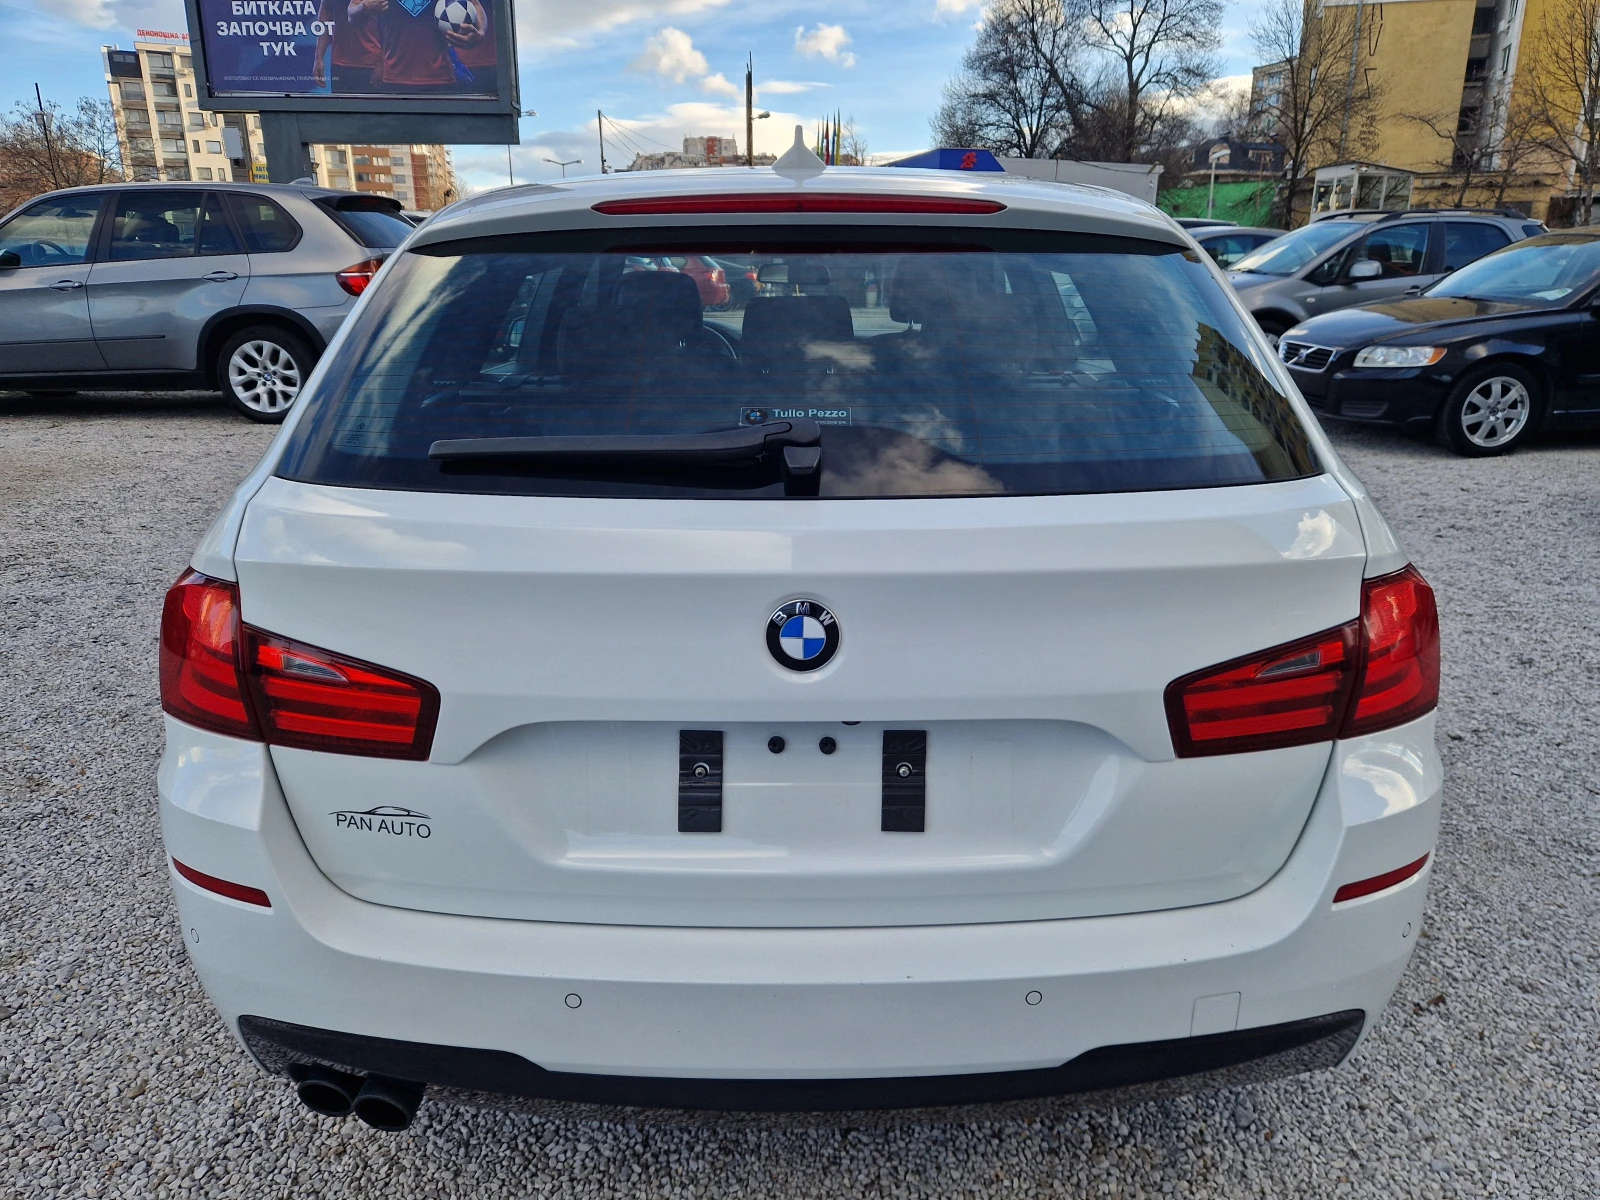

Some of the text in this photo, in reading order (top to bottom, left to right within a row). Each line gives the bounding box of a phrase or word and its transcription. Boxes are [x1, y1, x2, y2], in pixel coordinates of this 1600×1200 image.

[231, 1, 317, 16] БИТКАТА
[216, 21, 335, 36] ЗАПОЧВА ОТ
[259, 41, 298, 57] ТУК
[772, 408, 847, 418] Tullo Pezzo
[772, 602, 835, 627] BMW
[336, 813, 431, 839] PAN AUTO
